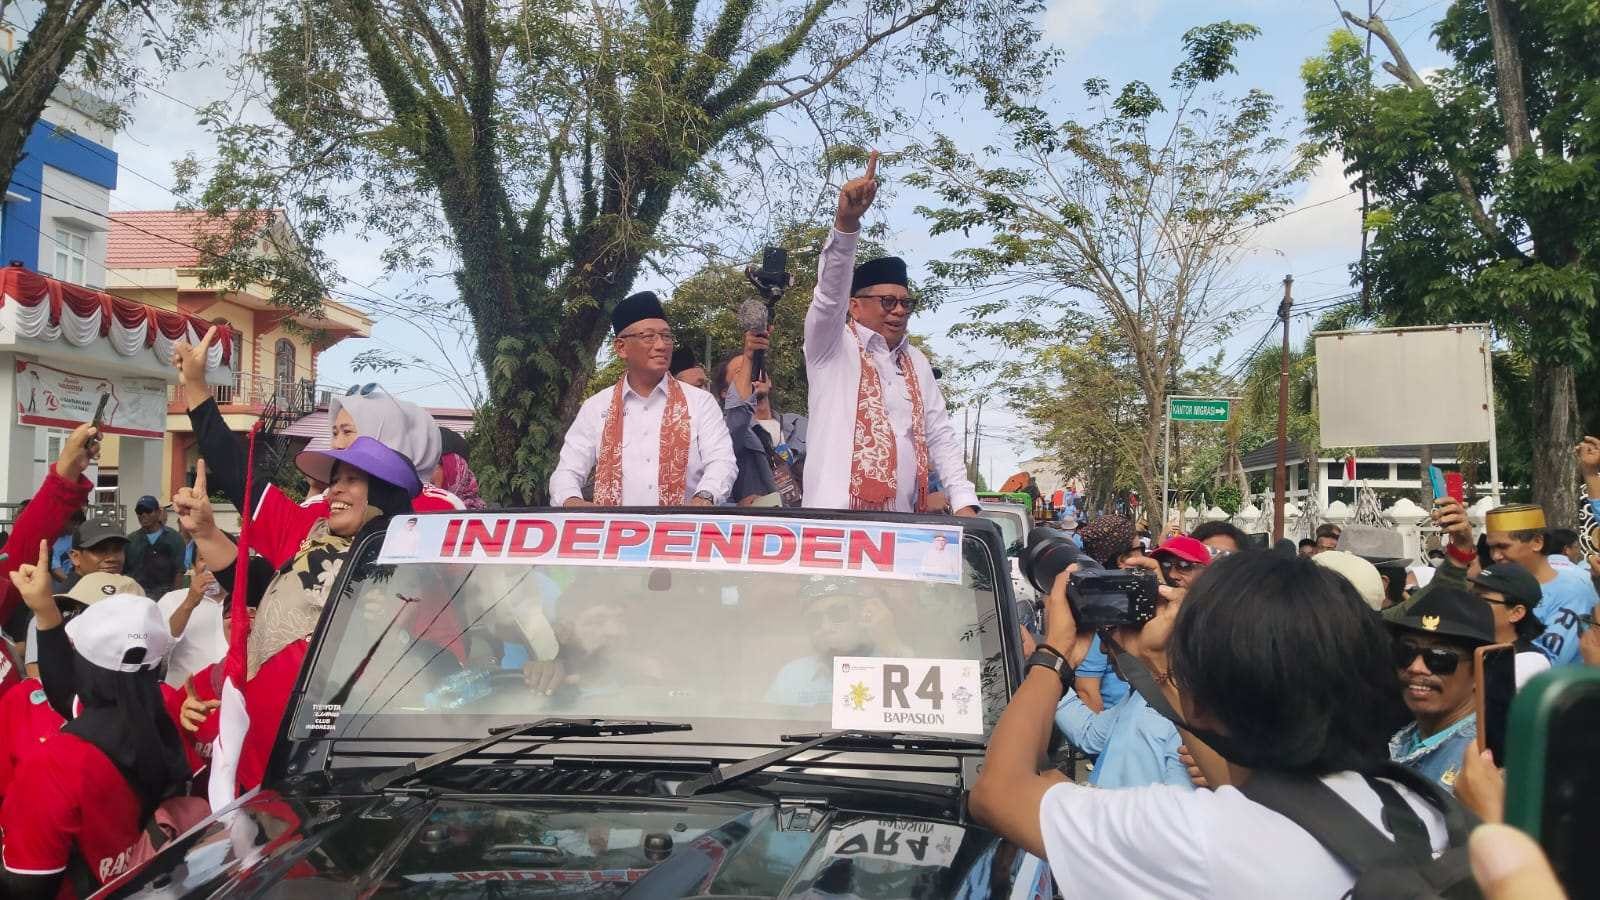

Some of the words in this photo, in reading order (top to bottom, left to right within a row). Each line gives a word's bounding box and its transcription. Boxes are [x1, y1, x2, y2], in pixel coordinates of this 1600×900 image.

[1172, 404, 1193, 415] KANTOR
[440, 518, 896, 572] INDEPENDEN
[882, 664, 944, 710] R4
[883, 711, 945, 726] BAPASLON
